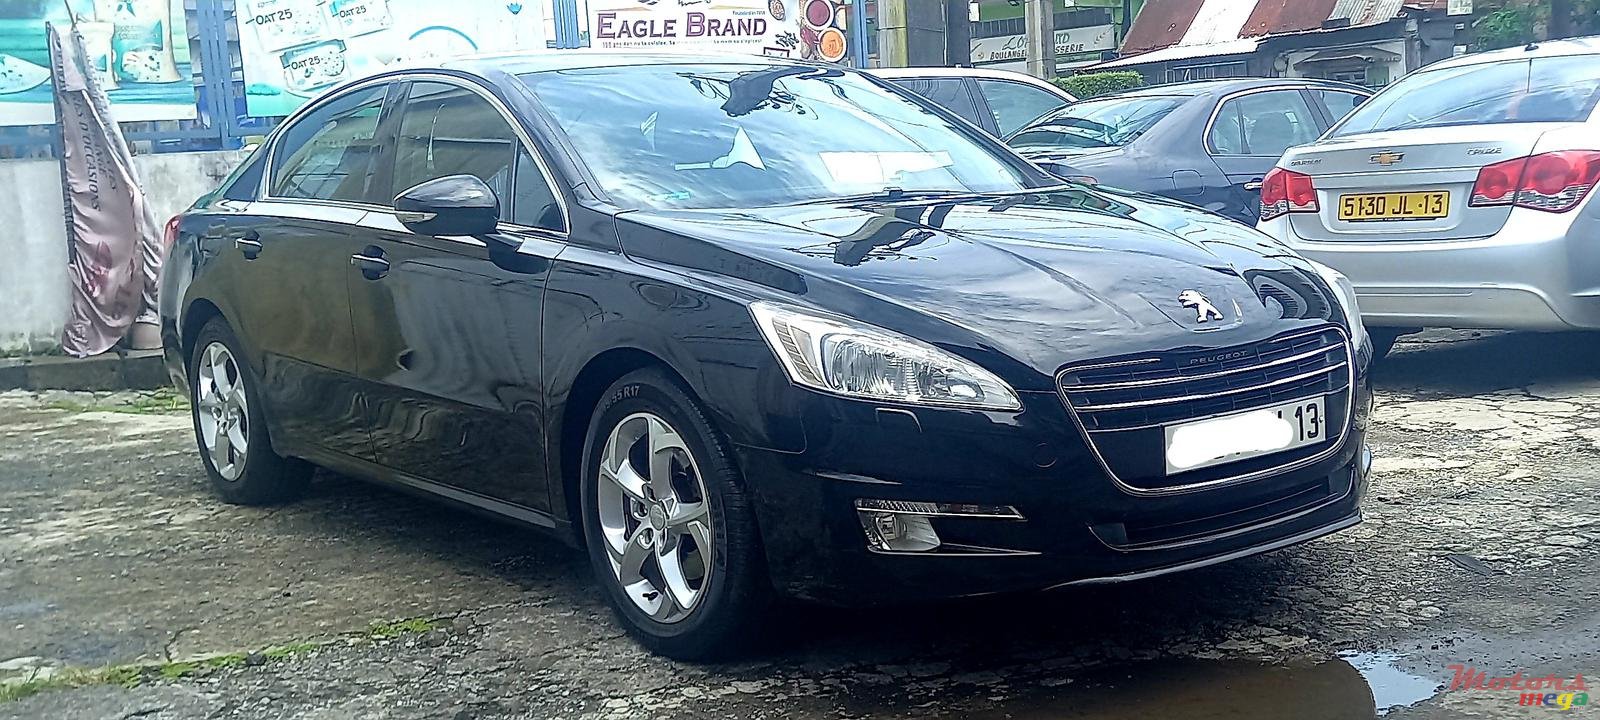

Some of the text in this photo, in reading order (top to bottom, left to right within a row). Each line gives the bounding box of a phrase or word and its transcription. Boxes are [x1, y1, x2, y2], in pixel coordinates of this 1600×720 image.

[255, 8, 293, 25] OAT 25
[339, 5, 367, 19] OAT 25
[597, 12, 767, 39] EAGLE BRAND
[990, 43, 1084, 61] BOULANGE SSERIE
[291, 55, 321, 70] OAT 25
[1344, 194, 1443, 217] 5130 JL 13
[1190, 350, 1248, 365] PEUGEOT
[623, 385, 640, 399] R17
[1294, 402, 1319, 441] 13
